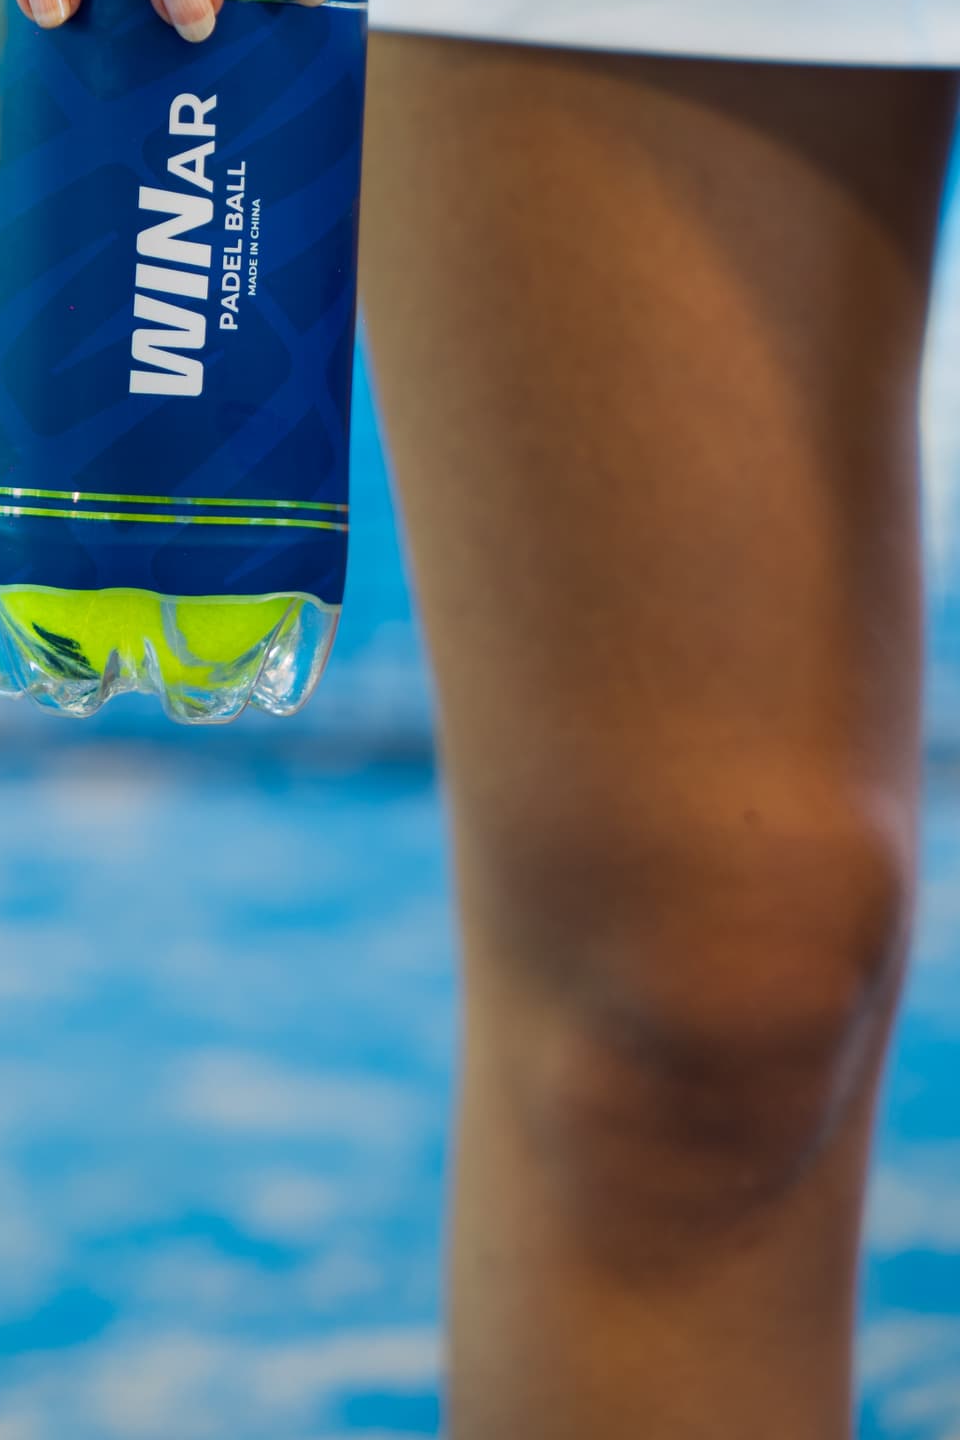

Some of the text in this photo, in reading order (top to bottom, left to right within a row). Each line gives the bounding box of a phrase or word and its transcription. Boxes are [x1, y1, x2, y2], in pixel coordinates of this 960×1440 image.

[219, 161, 246, 330] PADEL BALL
[247, 198, 261, 296] MADE IN CHINA
